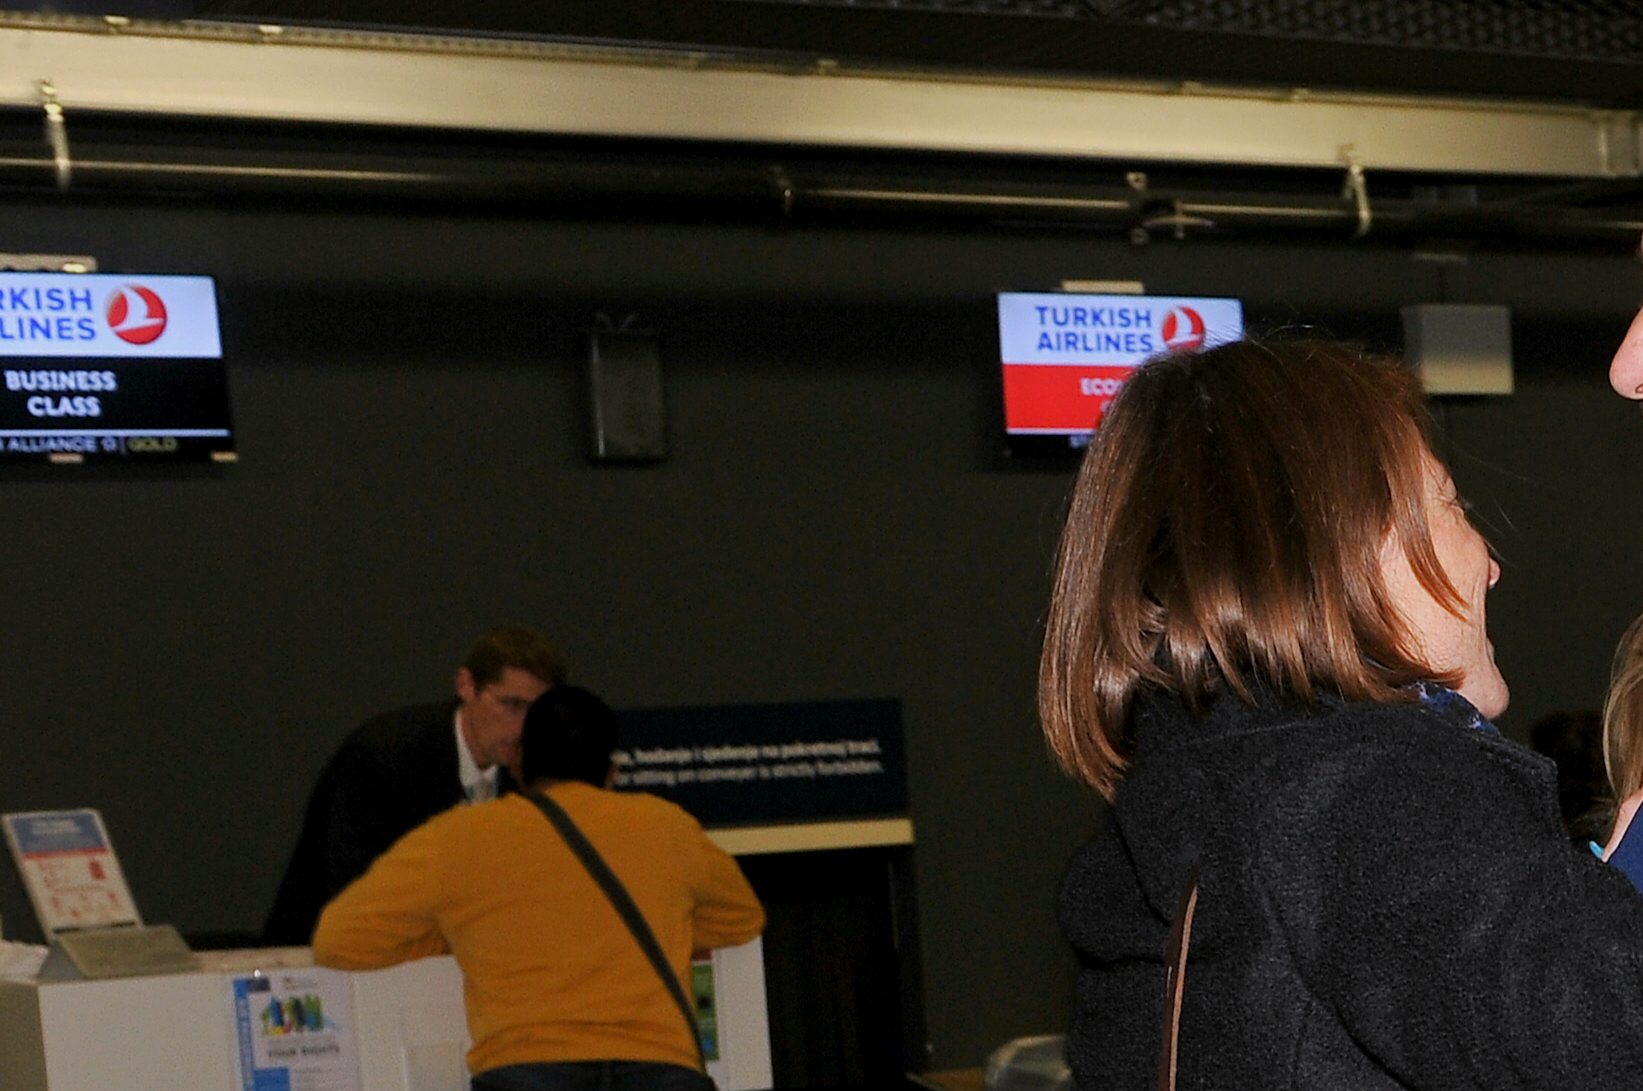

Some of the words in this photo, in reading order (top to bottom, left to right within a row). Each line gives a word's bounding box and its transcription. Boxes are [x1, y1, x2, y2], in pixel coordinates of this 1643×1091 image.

[1035, 305, 1151, 328] TURKISH
[1037, 332, 1153, 353] AIRLINES
[4, 369, 117, 392] BUSINESS
[1079, 377, 1124, 397] ECO
[26, 396, 102, 417] CLASS
